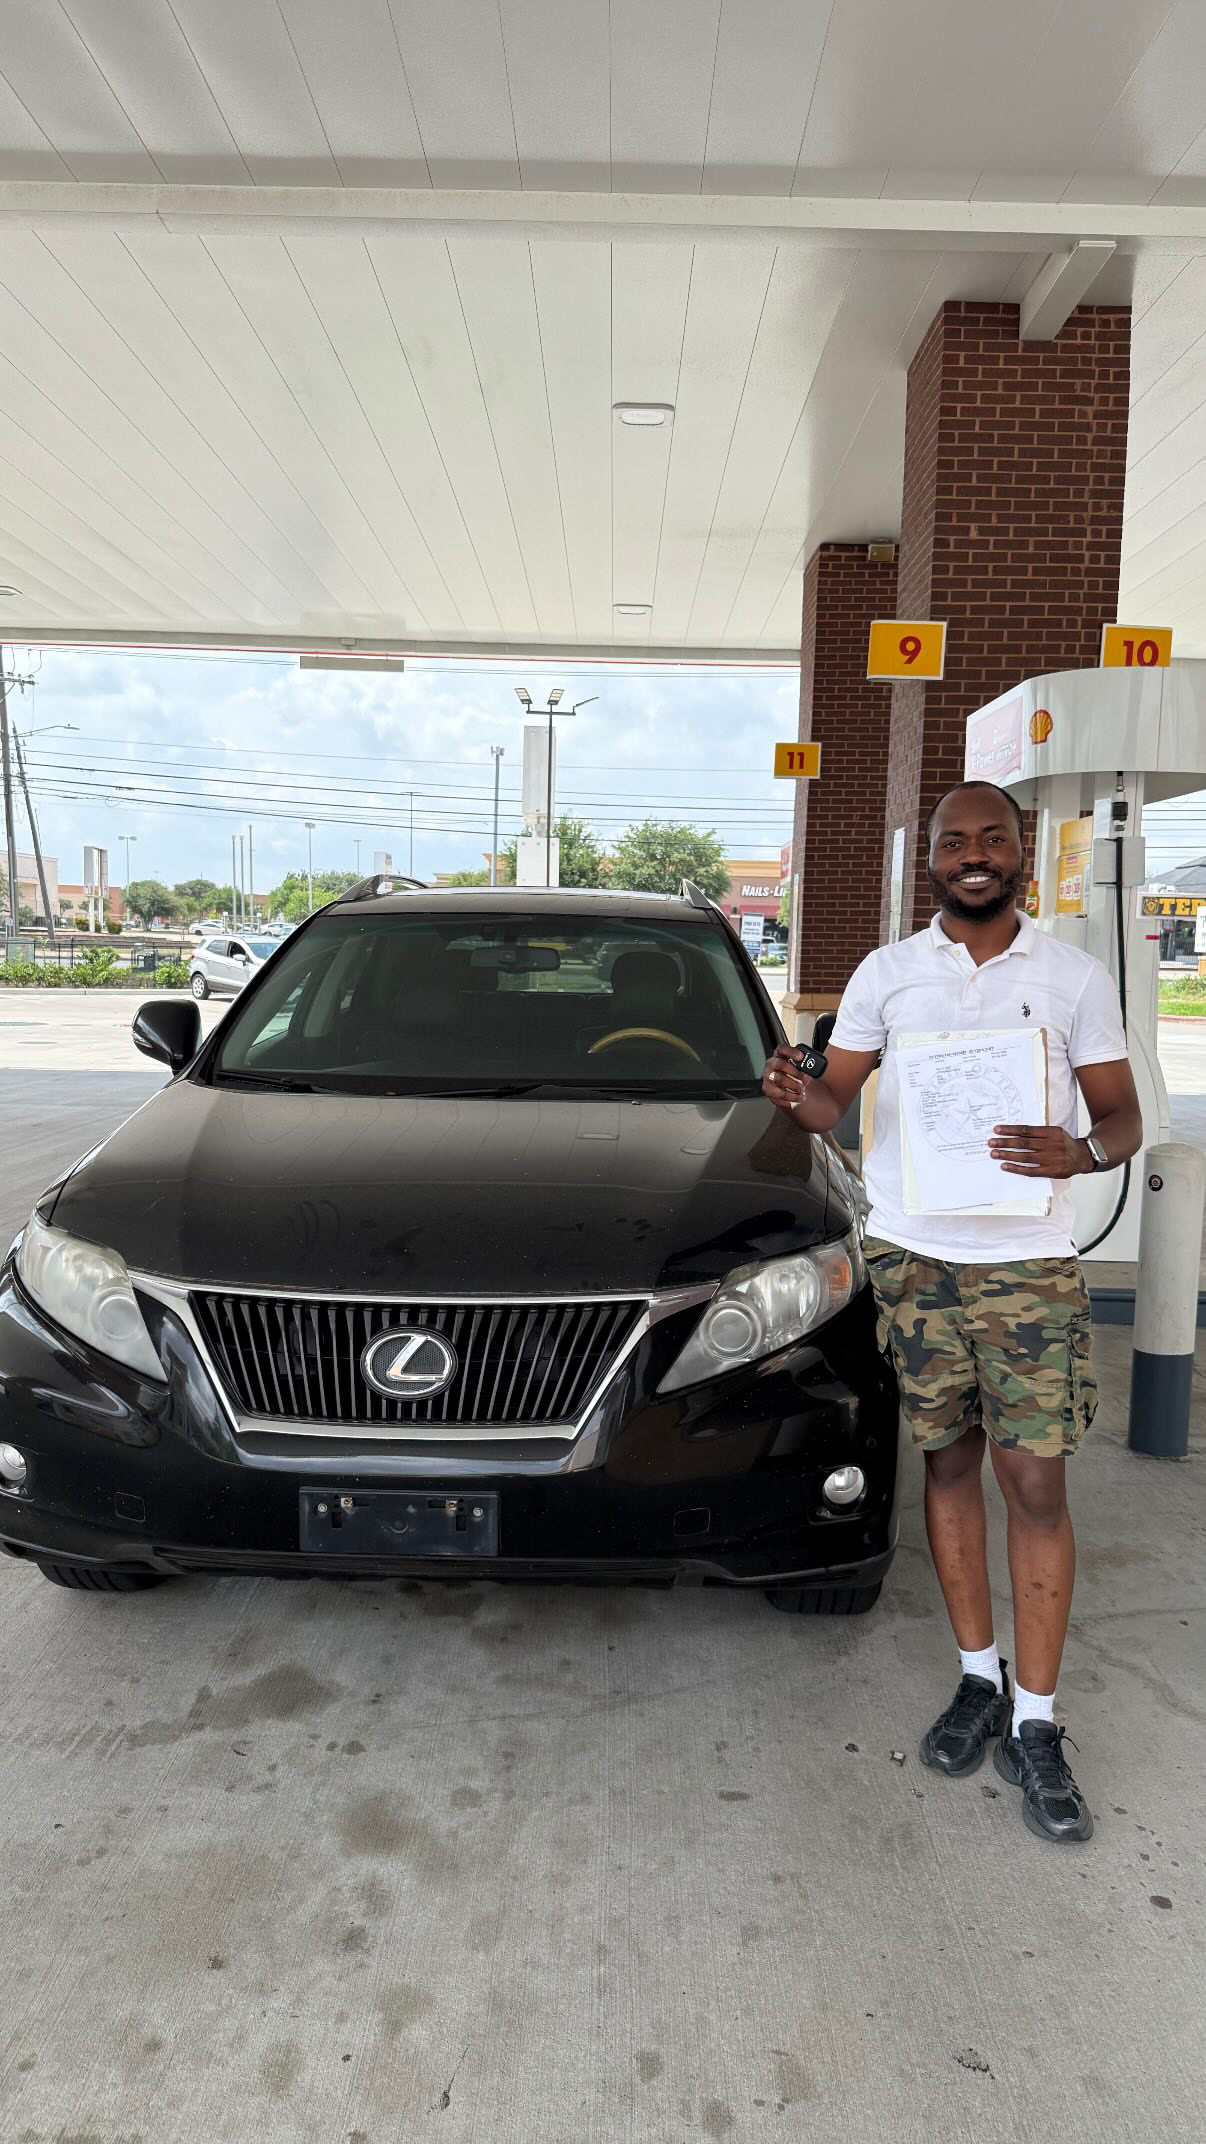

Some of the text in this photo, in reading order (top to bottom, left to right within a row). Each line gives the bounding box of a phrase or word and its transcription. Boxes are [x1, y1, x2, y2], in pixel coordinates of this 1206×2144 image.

[898, 635, 923, 665] 9
[1122, 640, 1159, 667] 10
[786, 751, 805, 770] 11
[741, 884, 786, 897] NAILS LI
